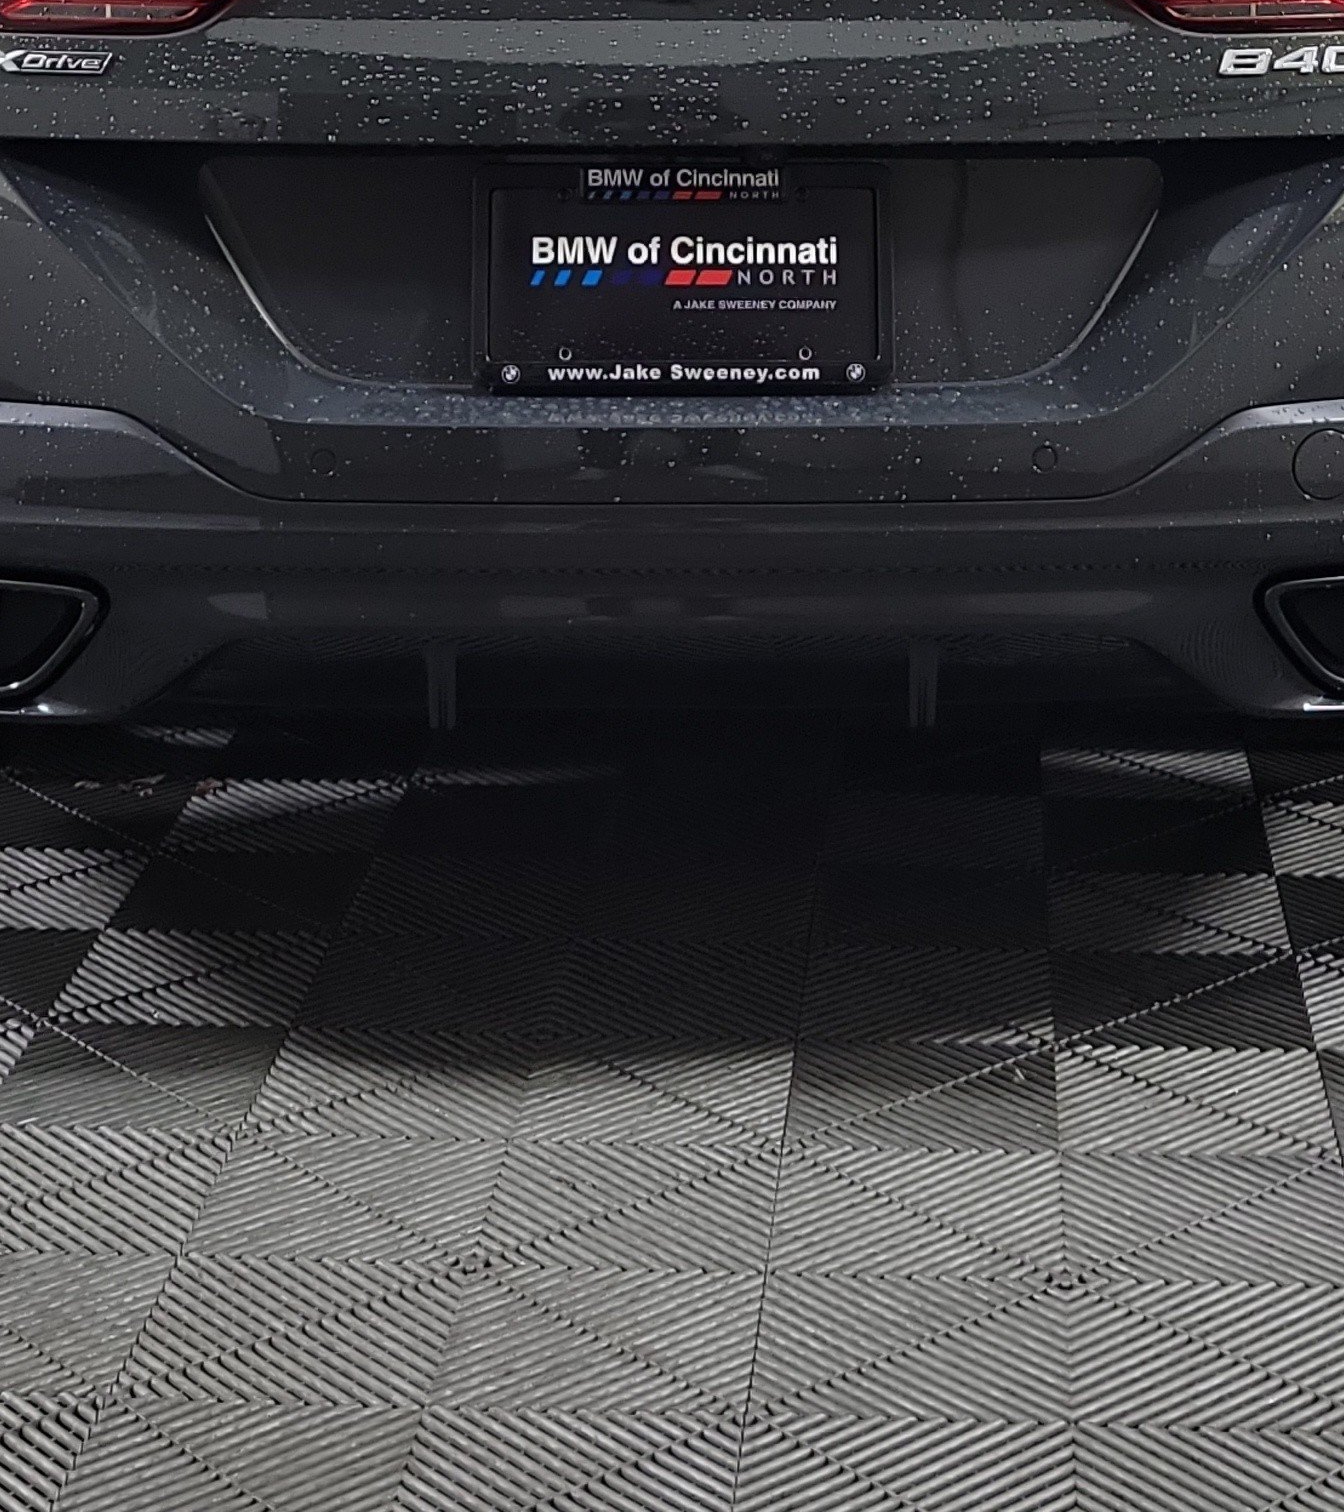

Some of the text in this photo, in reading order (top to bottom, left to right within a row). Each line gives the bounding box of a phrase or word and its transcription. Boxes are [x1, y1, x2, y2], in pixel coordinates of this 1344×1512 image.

[587, 168, 779, 187] BMW of Cincinnati
[729, 190, 779, 199] NORTH
[531, 236, 837, 265] BMW of Cincinnati
[737, 269, 837, 285] NORTH
[673, 300, 837, 310] A JAKE SWEENEY COMPANY
[548, 364, 821, 383] www.Jake Sweeney.com
